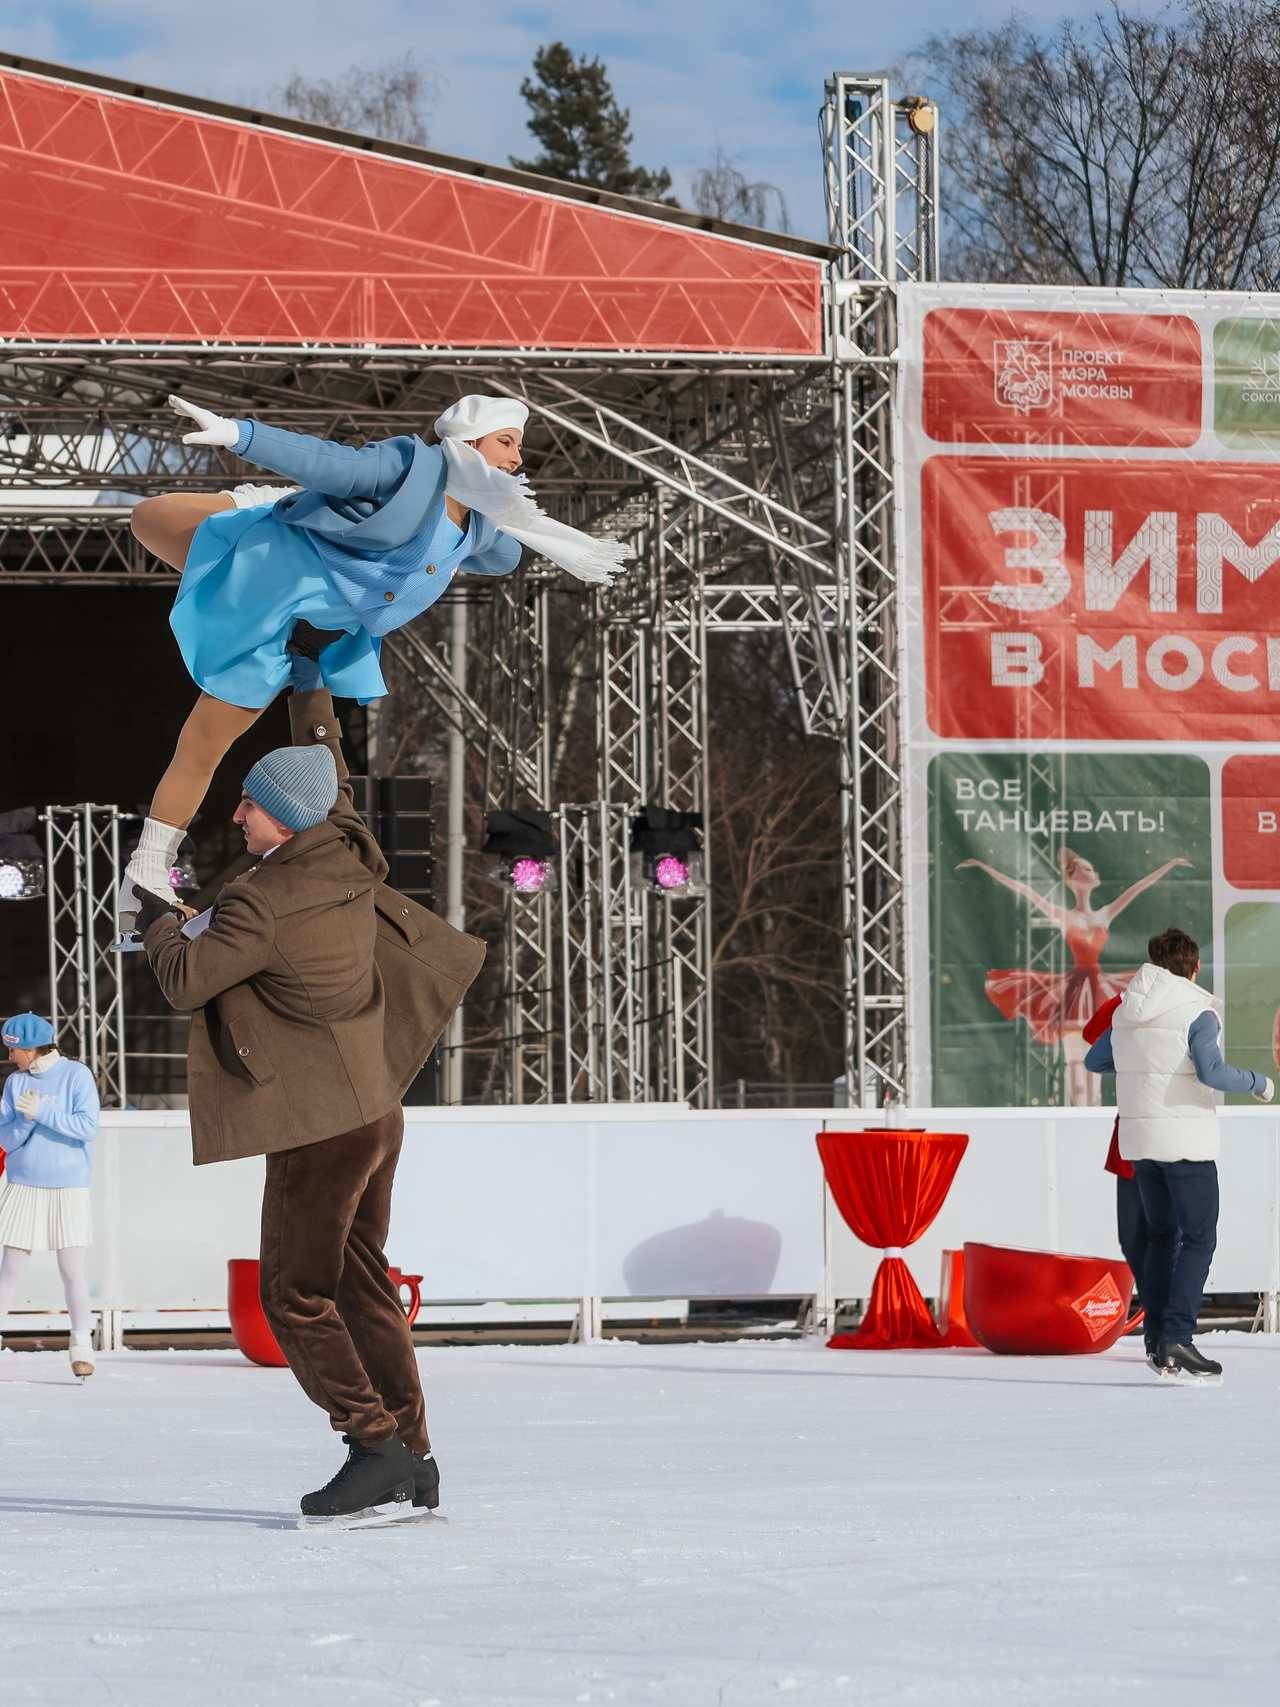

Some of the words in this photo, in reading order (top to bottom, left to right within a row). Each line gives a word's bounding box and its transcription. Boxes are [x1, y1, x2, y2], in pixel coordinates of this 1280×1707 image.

[1061, 349, 1125, 365] ПРОЕКТ
[1061, 366, 1108, 382] МЭРА
[1061, 383, 1133, 400] МОСКВЫ
[990, 632, 1045, 687] В
[955, 778, 1021, 800] ВСЕ
[955, 809, 1164, 838] ТАНЦЕВАТЬ!
